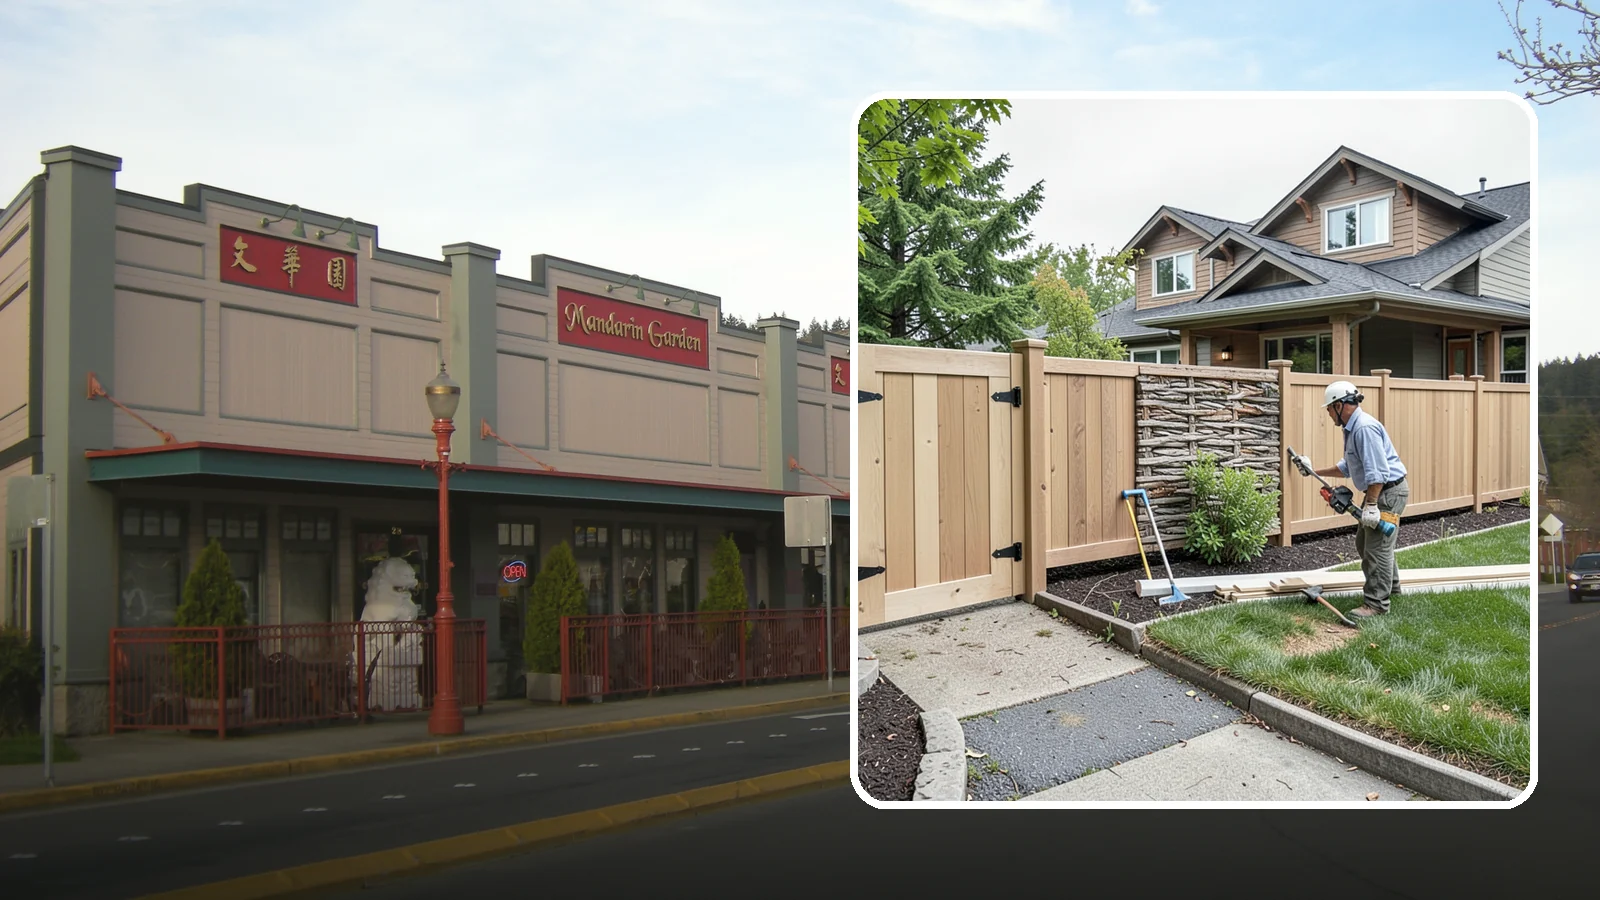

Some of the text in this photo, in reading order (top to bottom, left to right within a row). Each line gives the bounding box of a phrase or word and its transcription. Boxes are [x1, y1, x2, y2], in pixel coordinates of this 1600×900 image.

[231, 235, 346, 291] 文華園
[564, 302, 701, 352] Mandarin Garden
[503, 565, 527, 578] OPEN
